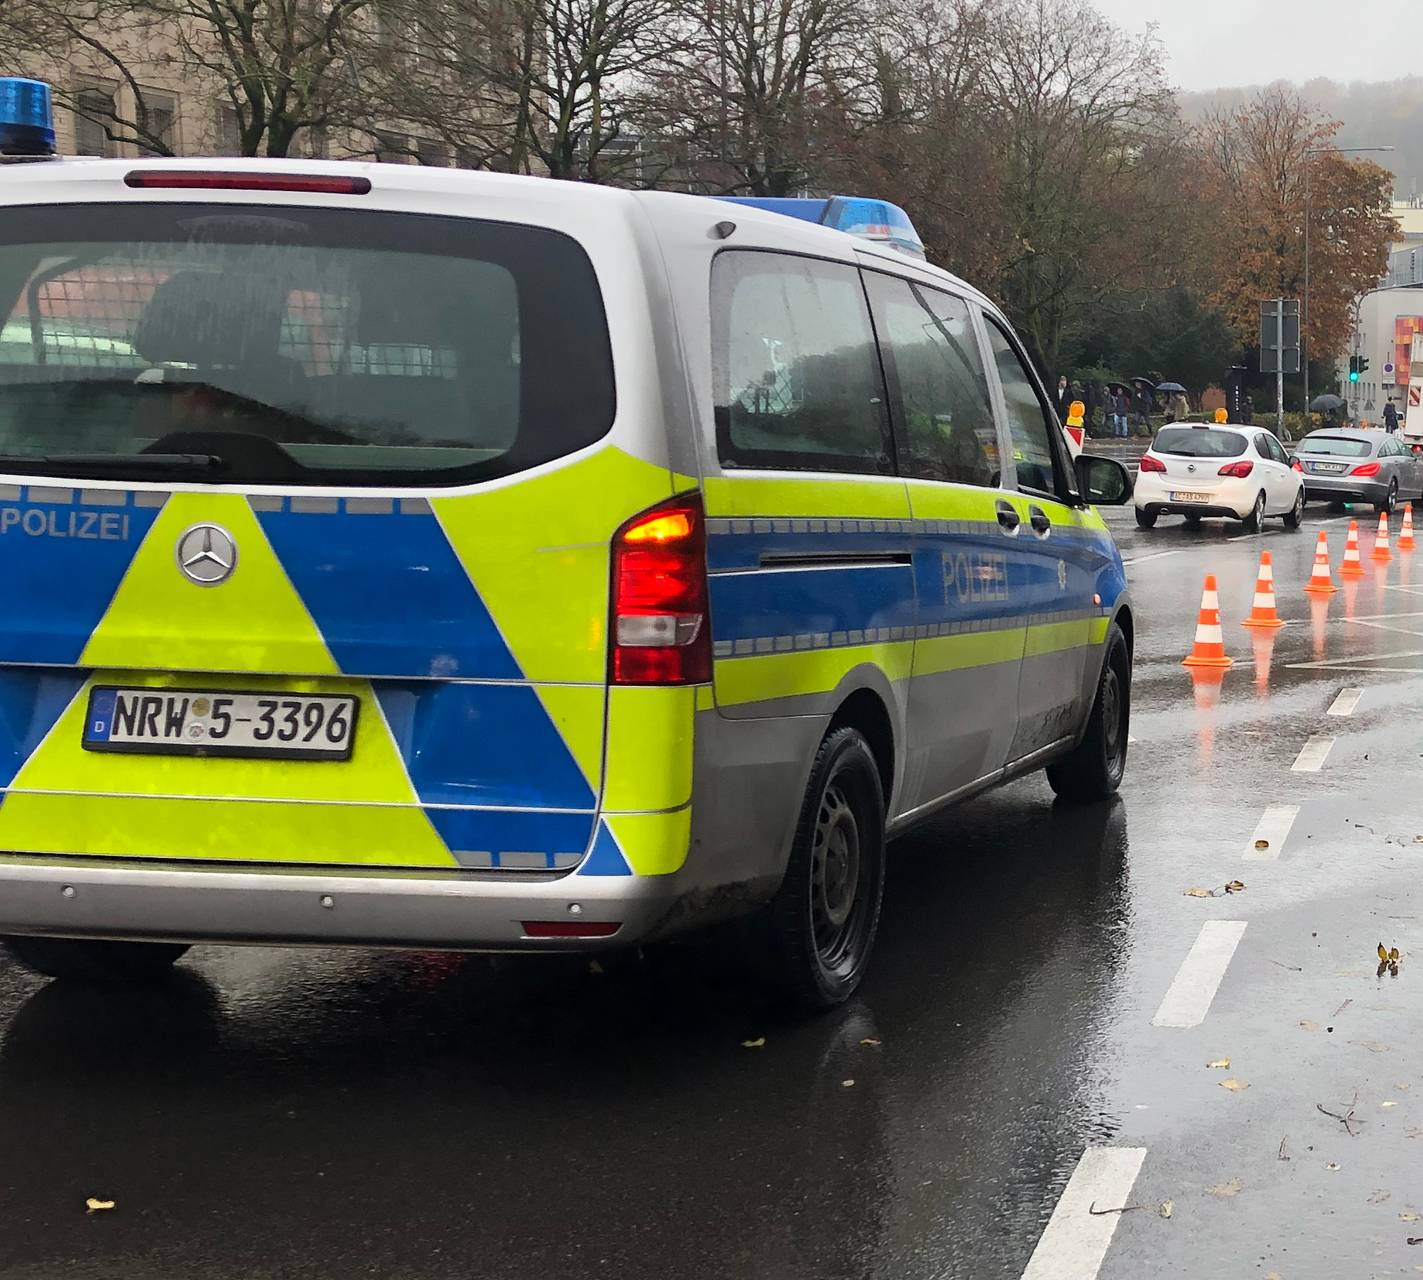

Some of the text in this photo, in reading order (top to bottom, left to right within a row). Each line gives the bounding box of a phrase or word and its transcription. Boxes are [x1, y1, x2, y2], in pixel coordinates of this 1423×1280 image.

[0, 508, 129, 540] POLIZEI
[94, 721, 105, 733] D
[112, 695, 350, 744] NRW 5-3396
